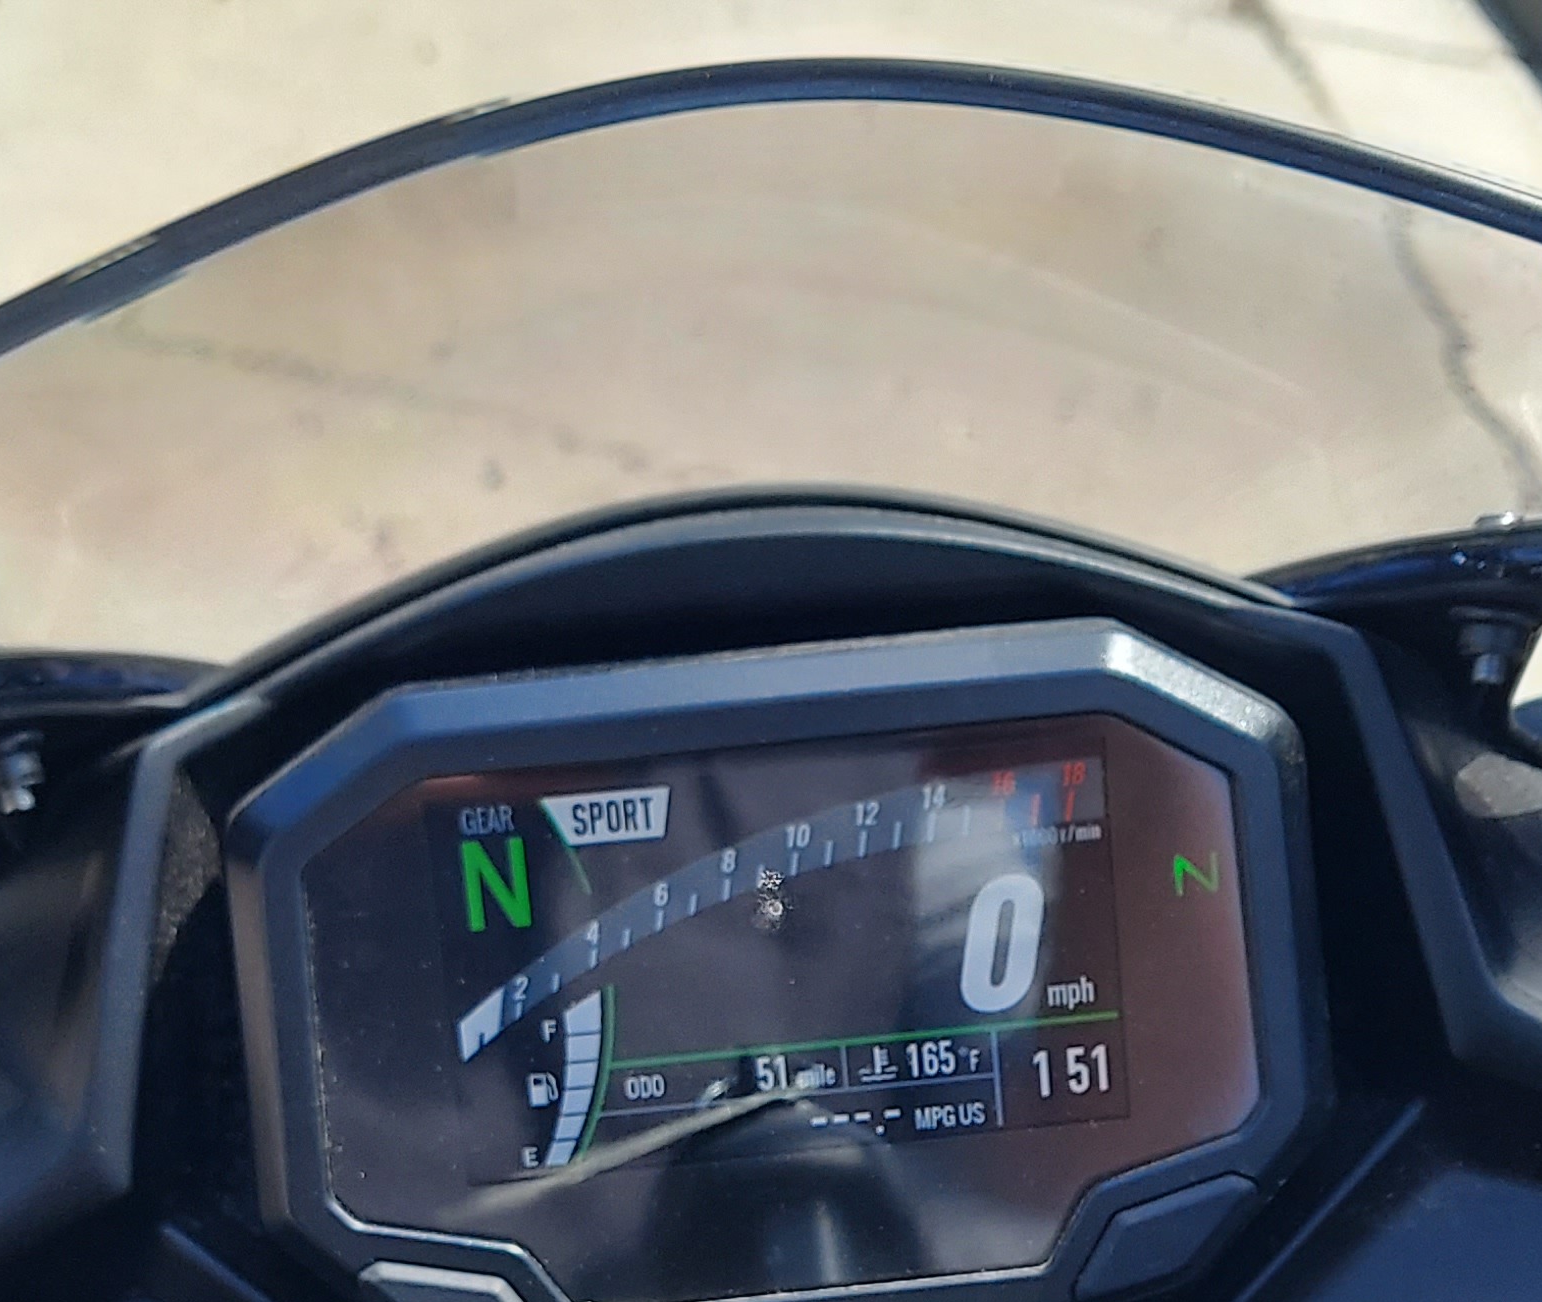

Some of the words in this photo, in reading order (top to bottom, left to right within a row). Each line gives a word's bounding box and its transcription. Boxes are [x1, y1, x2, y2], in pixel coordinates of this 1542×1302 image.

[922, 783, 947, 810] 14
[461, 804, 515, 837] GEAR
[572, 796, 655, 836] SPORT
[855, 801, 880, 827] 12
[785, 824, 811, 849] 10
[721, 848, 737, 873] 8
[1172, 851, 1220, 897] N
[461, 835, 533, 933] N
[654, 880, 669, 907] 6
[586, 918, 601, 945] 4
[960, 873, 1045, 1014] 0
[511, 975, 529, 1001] 2
[1046, 976, 1096, 1010] mph
[540, 1019, 558, 1043] F
[906, 1040, 957, 1079] 165
[623, 1074, 665, 1100] ODO
[755, 1054, 789, 1092] 51
[914, 1107, 957, 1131] MPG
[959, 1102, 986, 1127] US
[522, 1147, 541, 1169] E
